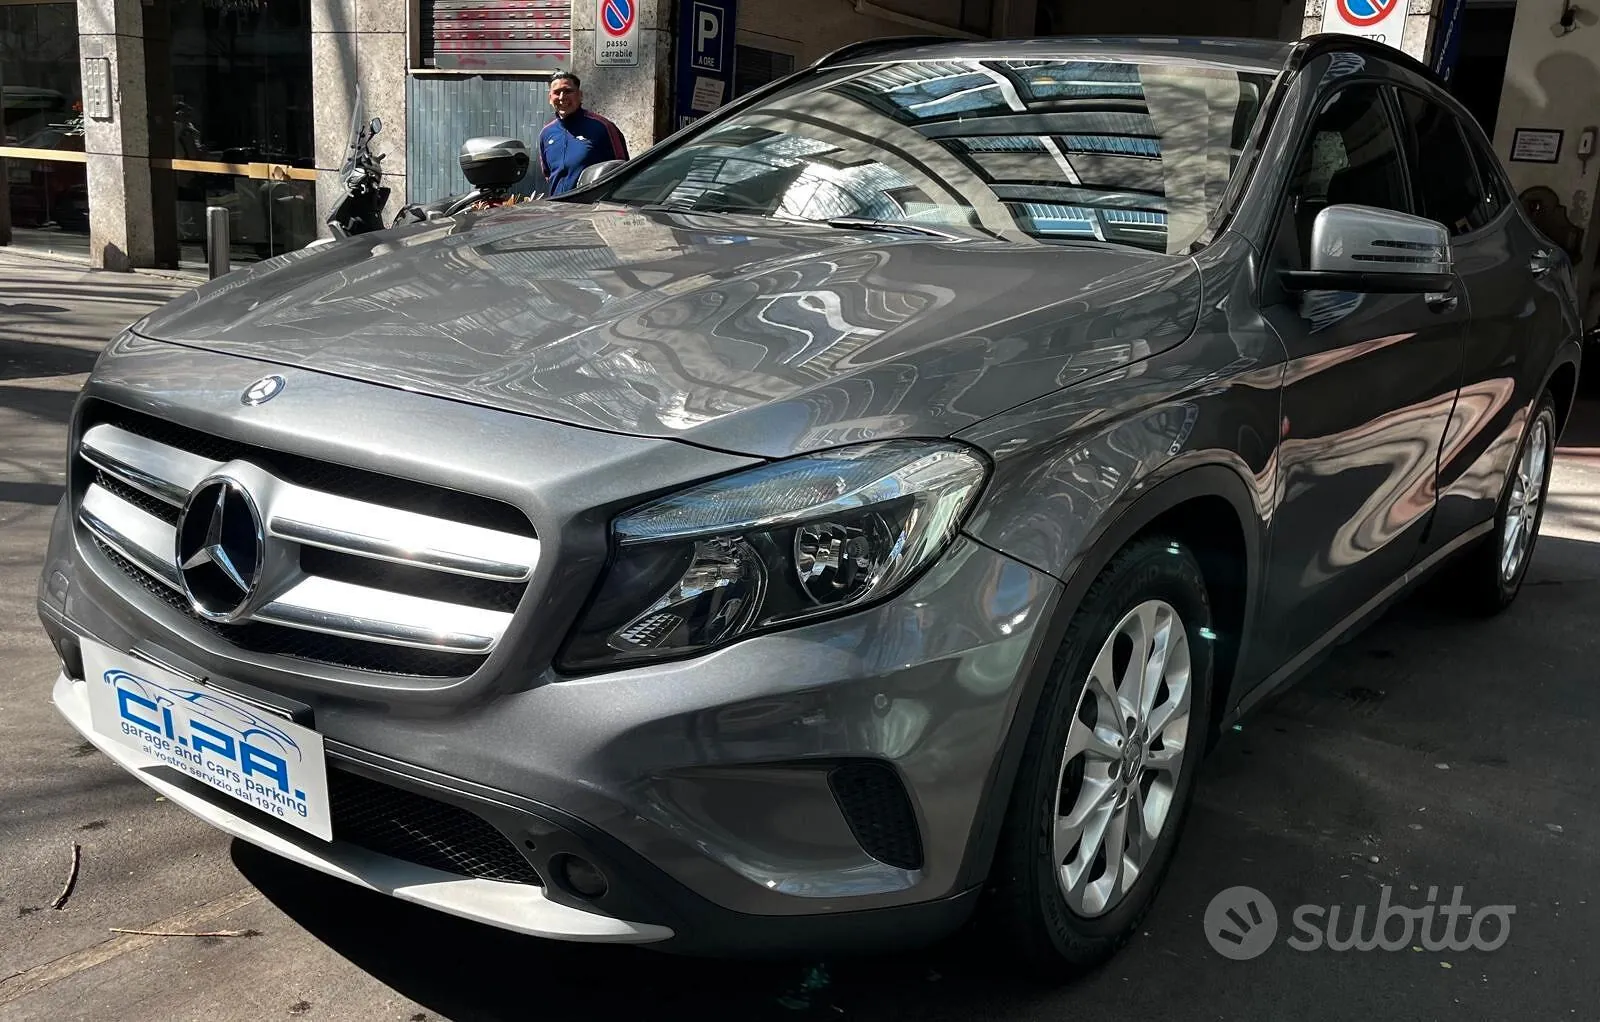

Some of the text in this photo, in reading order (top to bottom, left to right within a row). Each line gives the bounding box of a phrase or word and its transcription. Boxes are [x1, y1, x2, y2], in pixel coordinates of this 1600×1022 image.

[601, 49, 632, 57] carrabile
[698, 11, 718, 52] P
[698, 56, 715, 67] A ORE
[117, 687, 306, 801] CI.PA.
[121, 721, 307, 818] garage and cars parking
[143, 745, 284, 817] al vostro servizio dal 1976
